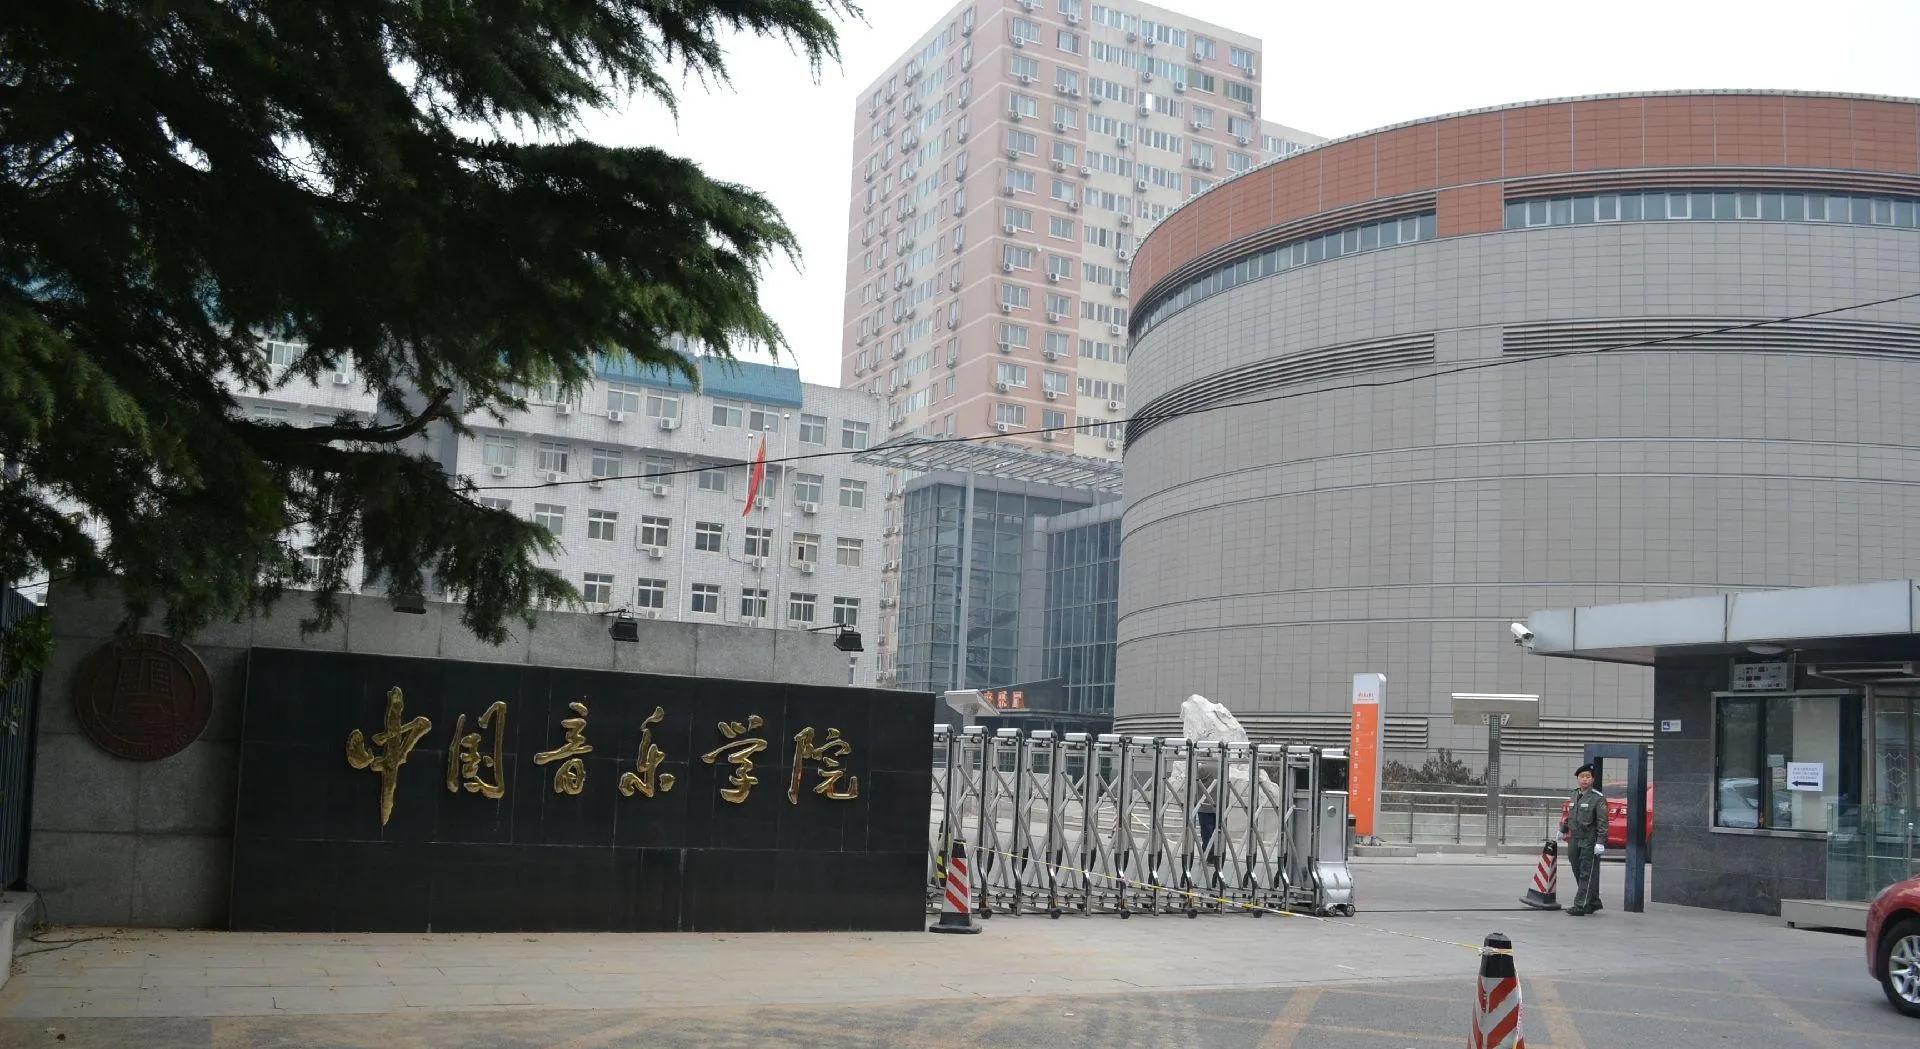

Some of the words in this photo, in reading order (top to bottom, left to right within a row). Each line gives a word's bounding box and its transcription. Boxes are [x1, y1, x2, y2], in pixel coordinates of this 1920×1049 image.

[345, 686, 858, 826] 中国音乐学院
